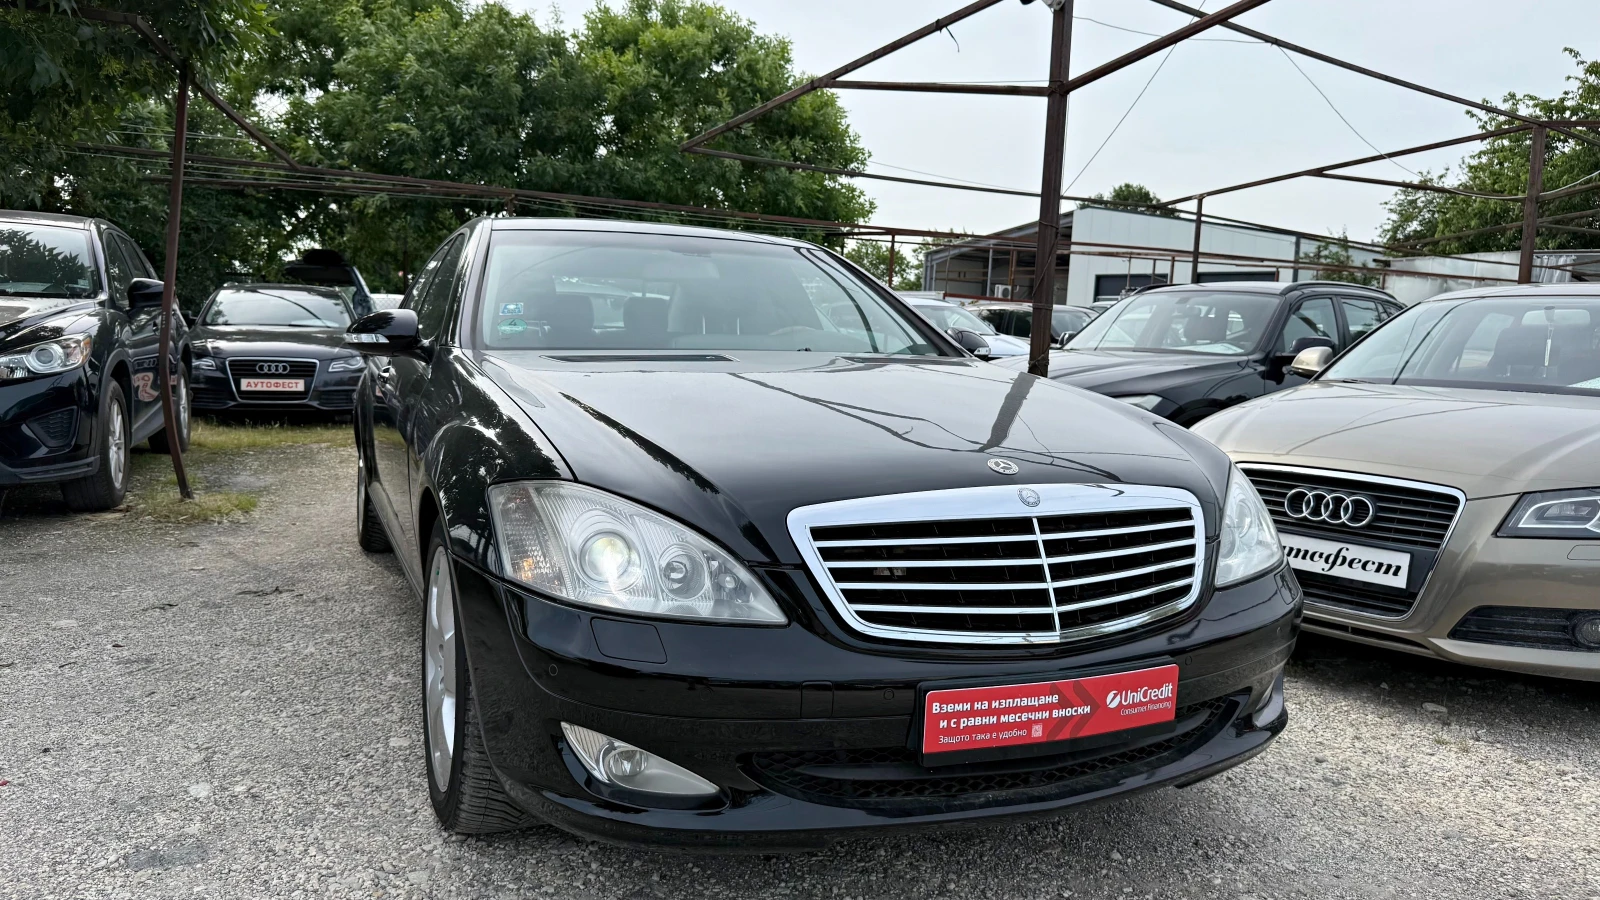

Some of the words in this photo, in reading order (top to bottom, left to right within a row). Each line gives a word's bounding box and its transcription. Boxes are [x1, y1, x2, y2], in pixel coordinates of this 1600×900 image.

[245, 381, 300, 389] АУТОФЕСТ
[1282, 545, 1402, 577] тофест
[932, 702, 971, 714] Вземи
[974, 701, 989, 711] на
[991, 694, 1059, 709] изплащане
[1121, 682, 1173, 706] UniCredit
[939, 720, 948, 729] и
[950, 719, 957, 728] с
[960, 716, 997, 729] равни
[1000, 709, 1050, 724] месечни
[1052, 705, 1091, 718] вноски
[1120, 705, 1147, 716] Consumer
[1147, 700, 1172, 711] Financing
[938, 735, 970, 744] Защото
[972, 732, 991, 741] така
[992, 731, 997, 739] е
[998, 728, 1028, 740] удобно
